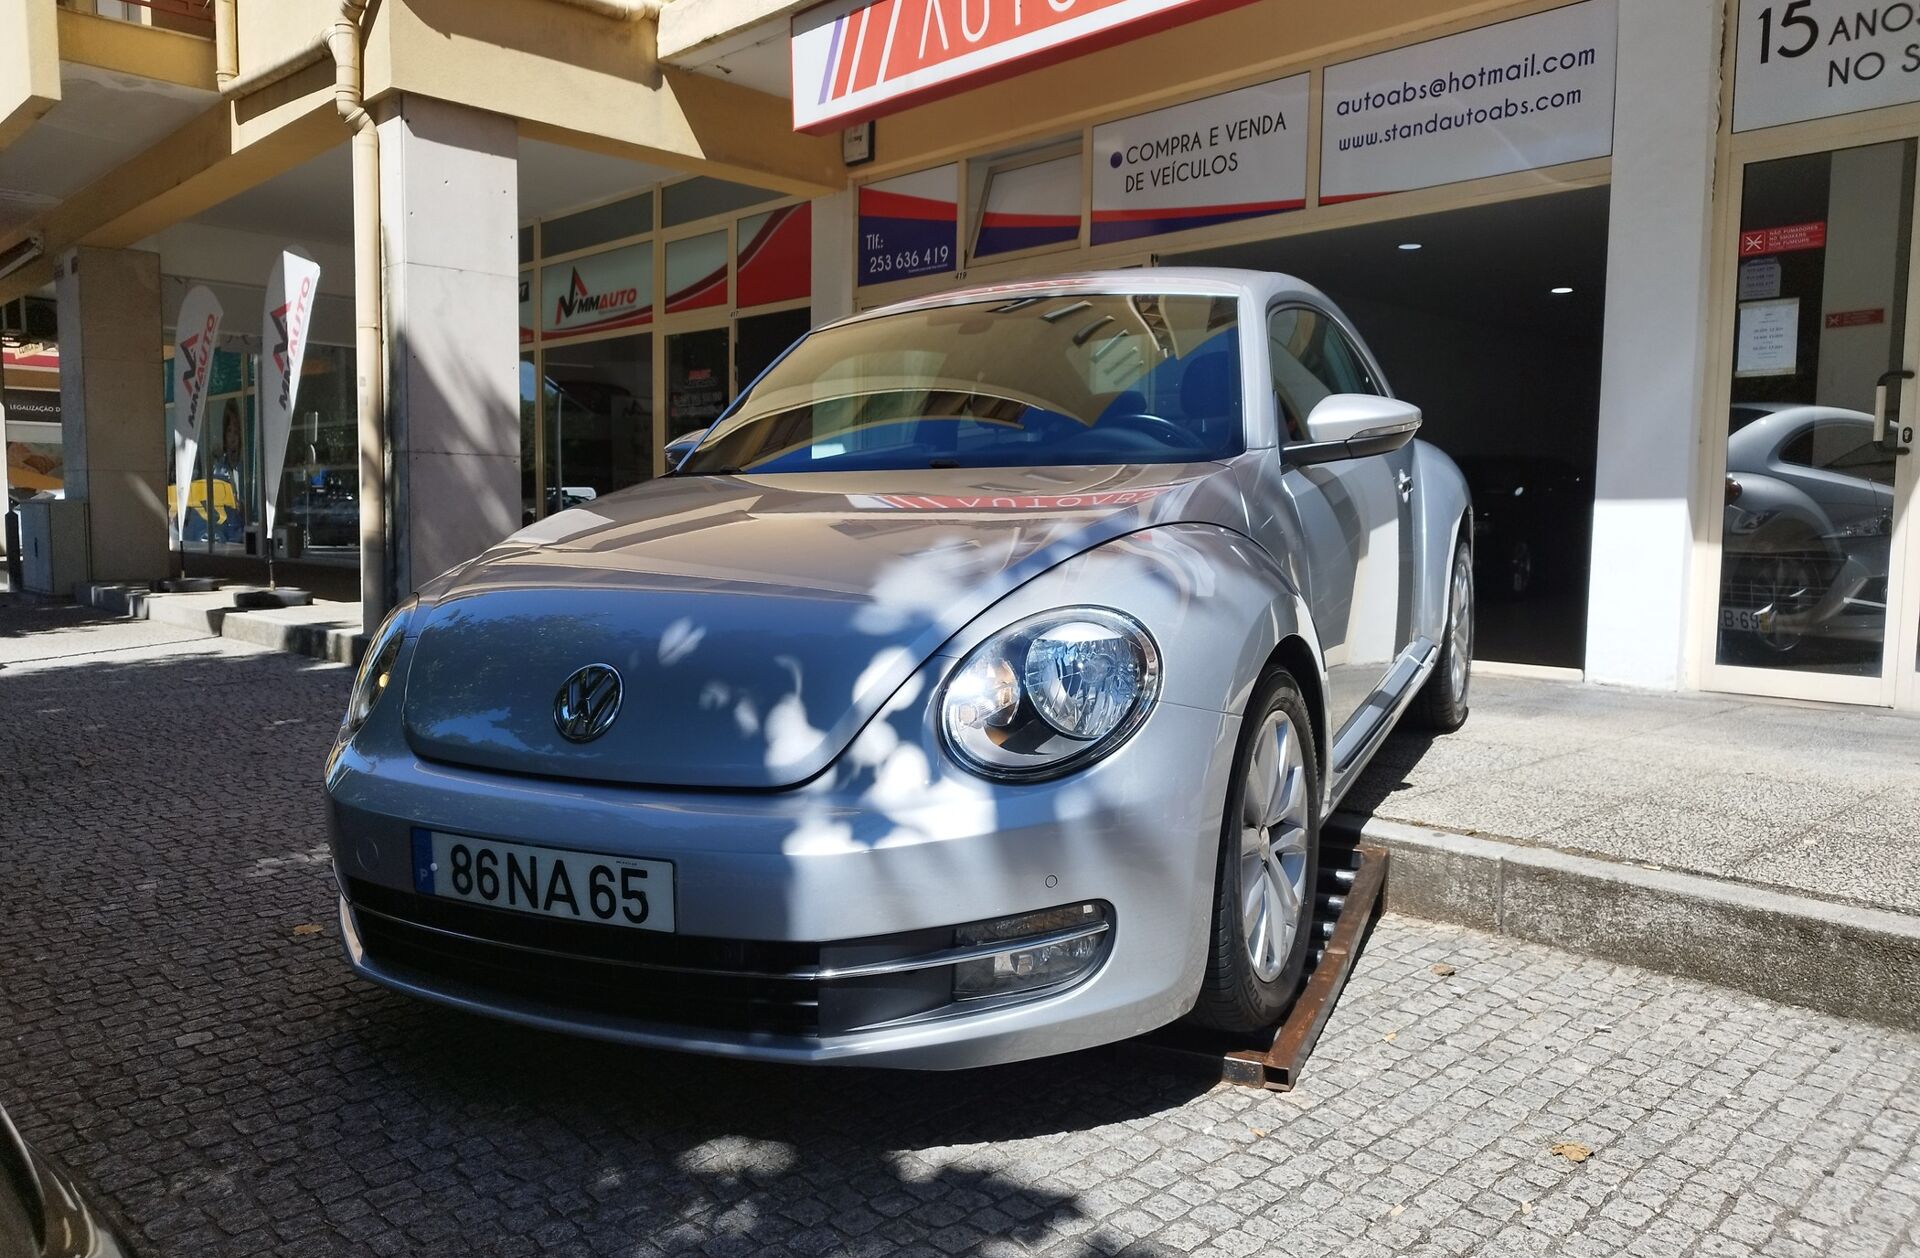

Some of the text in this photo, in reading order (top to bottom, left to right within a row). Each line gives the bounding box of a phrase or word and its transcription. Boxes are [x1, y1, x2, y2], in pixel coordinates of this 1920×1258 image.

[918, 0, 1076, 59] AU
[1757, 0, 1920, 64] 15 ANO
[1336, 47, 1595, 116] autoabs@hotmail.com
[1827, 52, 1885, 87] NO
[1125, 110, 1286, 165] COMPRA E VENDA
[1338, 87, 1582, 152] www.standautoabs.com
[1125, 151, 1239, 193] DE VEÍCULOS
[869, 254, 892, 273] 253
[895, 250, 919, 269] 636
[924, 245, 949, 265] 419
[577, 288, 637, 314] MMAUTO
